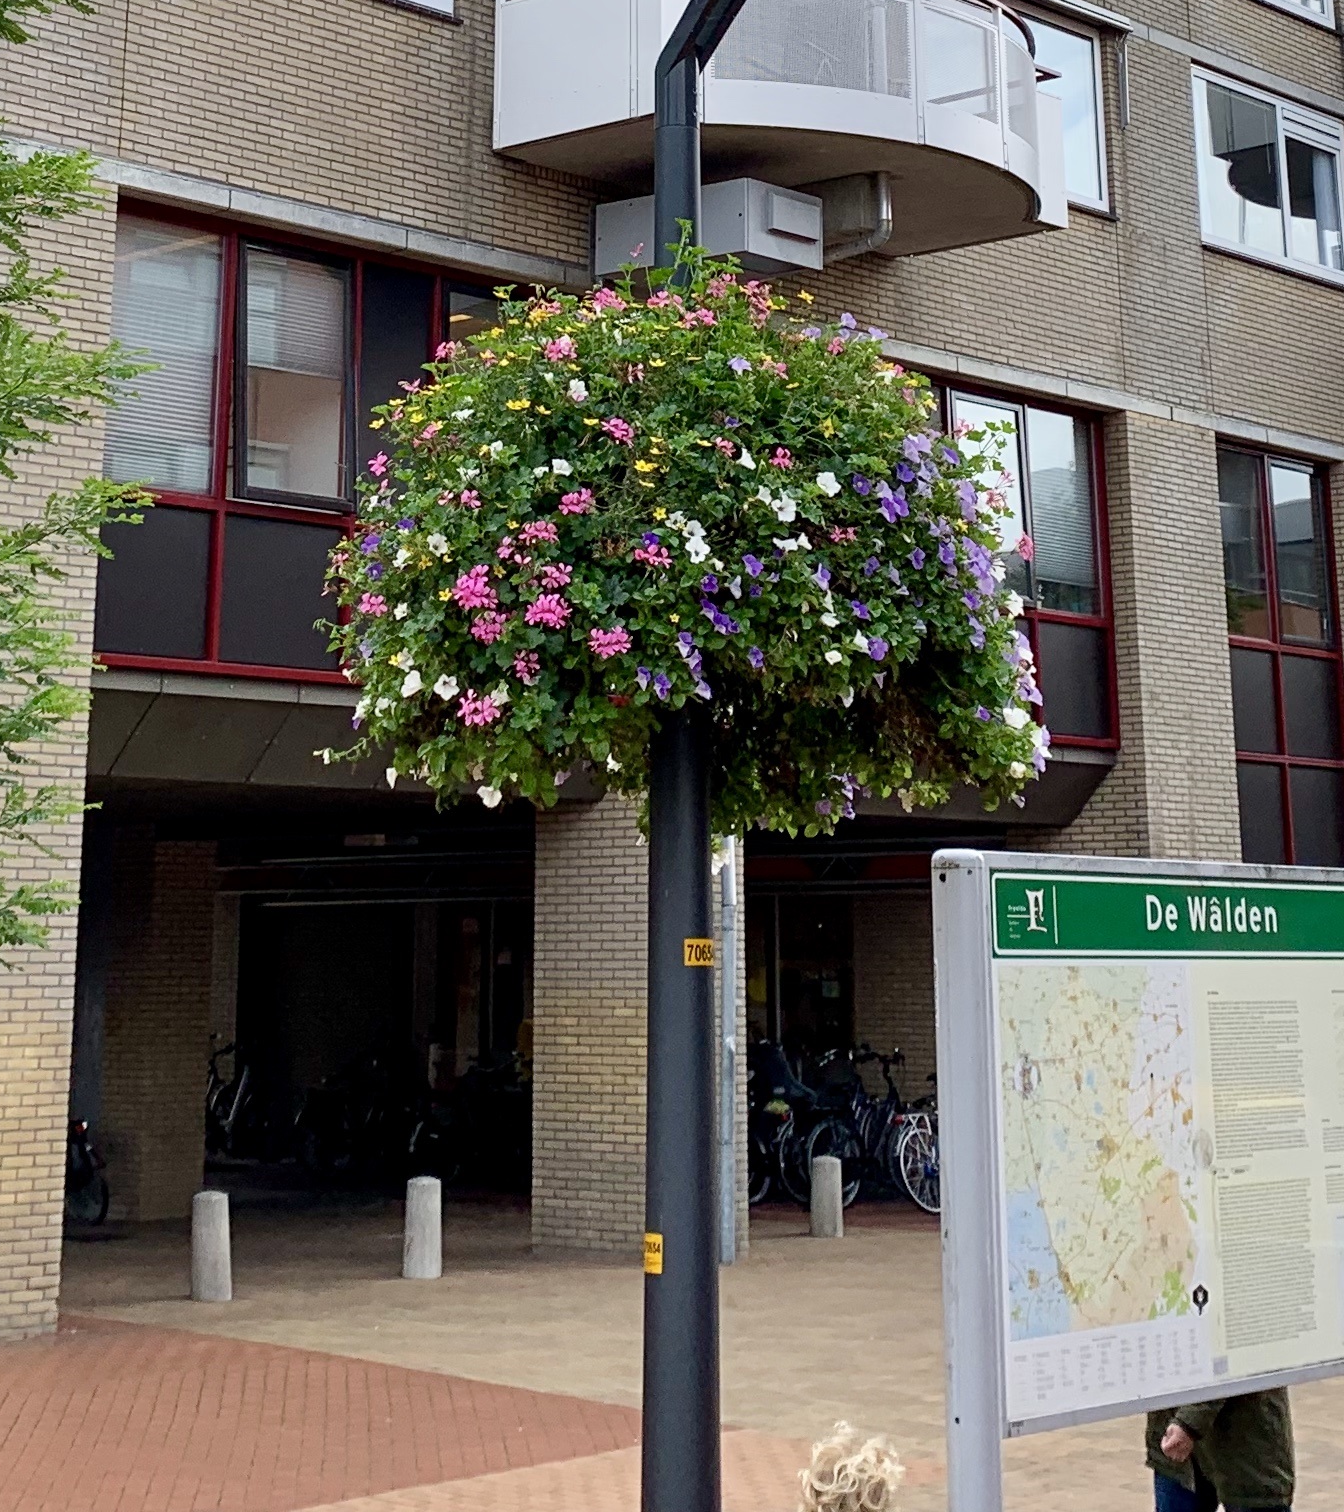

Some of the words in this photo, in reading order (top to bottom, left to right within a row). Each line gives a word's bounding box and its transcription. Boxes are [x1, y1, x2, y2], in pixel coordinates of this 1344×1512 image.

[1145, 894, 1178, 931] De
[1187, 895, 1278, 934] Wâlden
[687, 944, 714, 962] 7065
